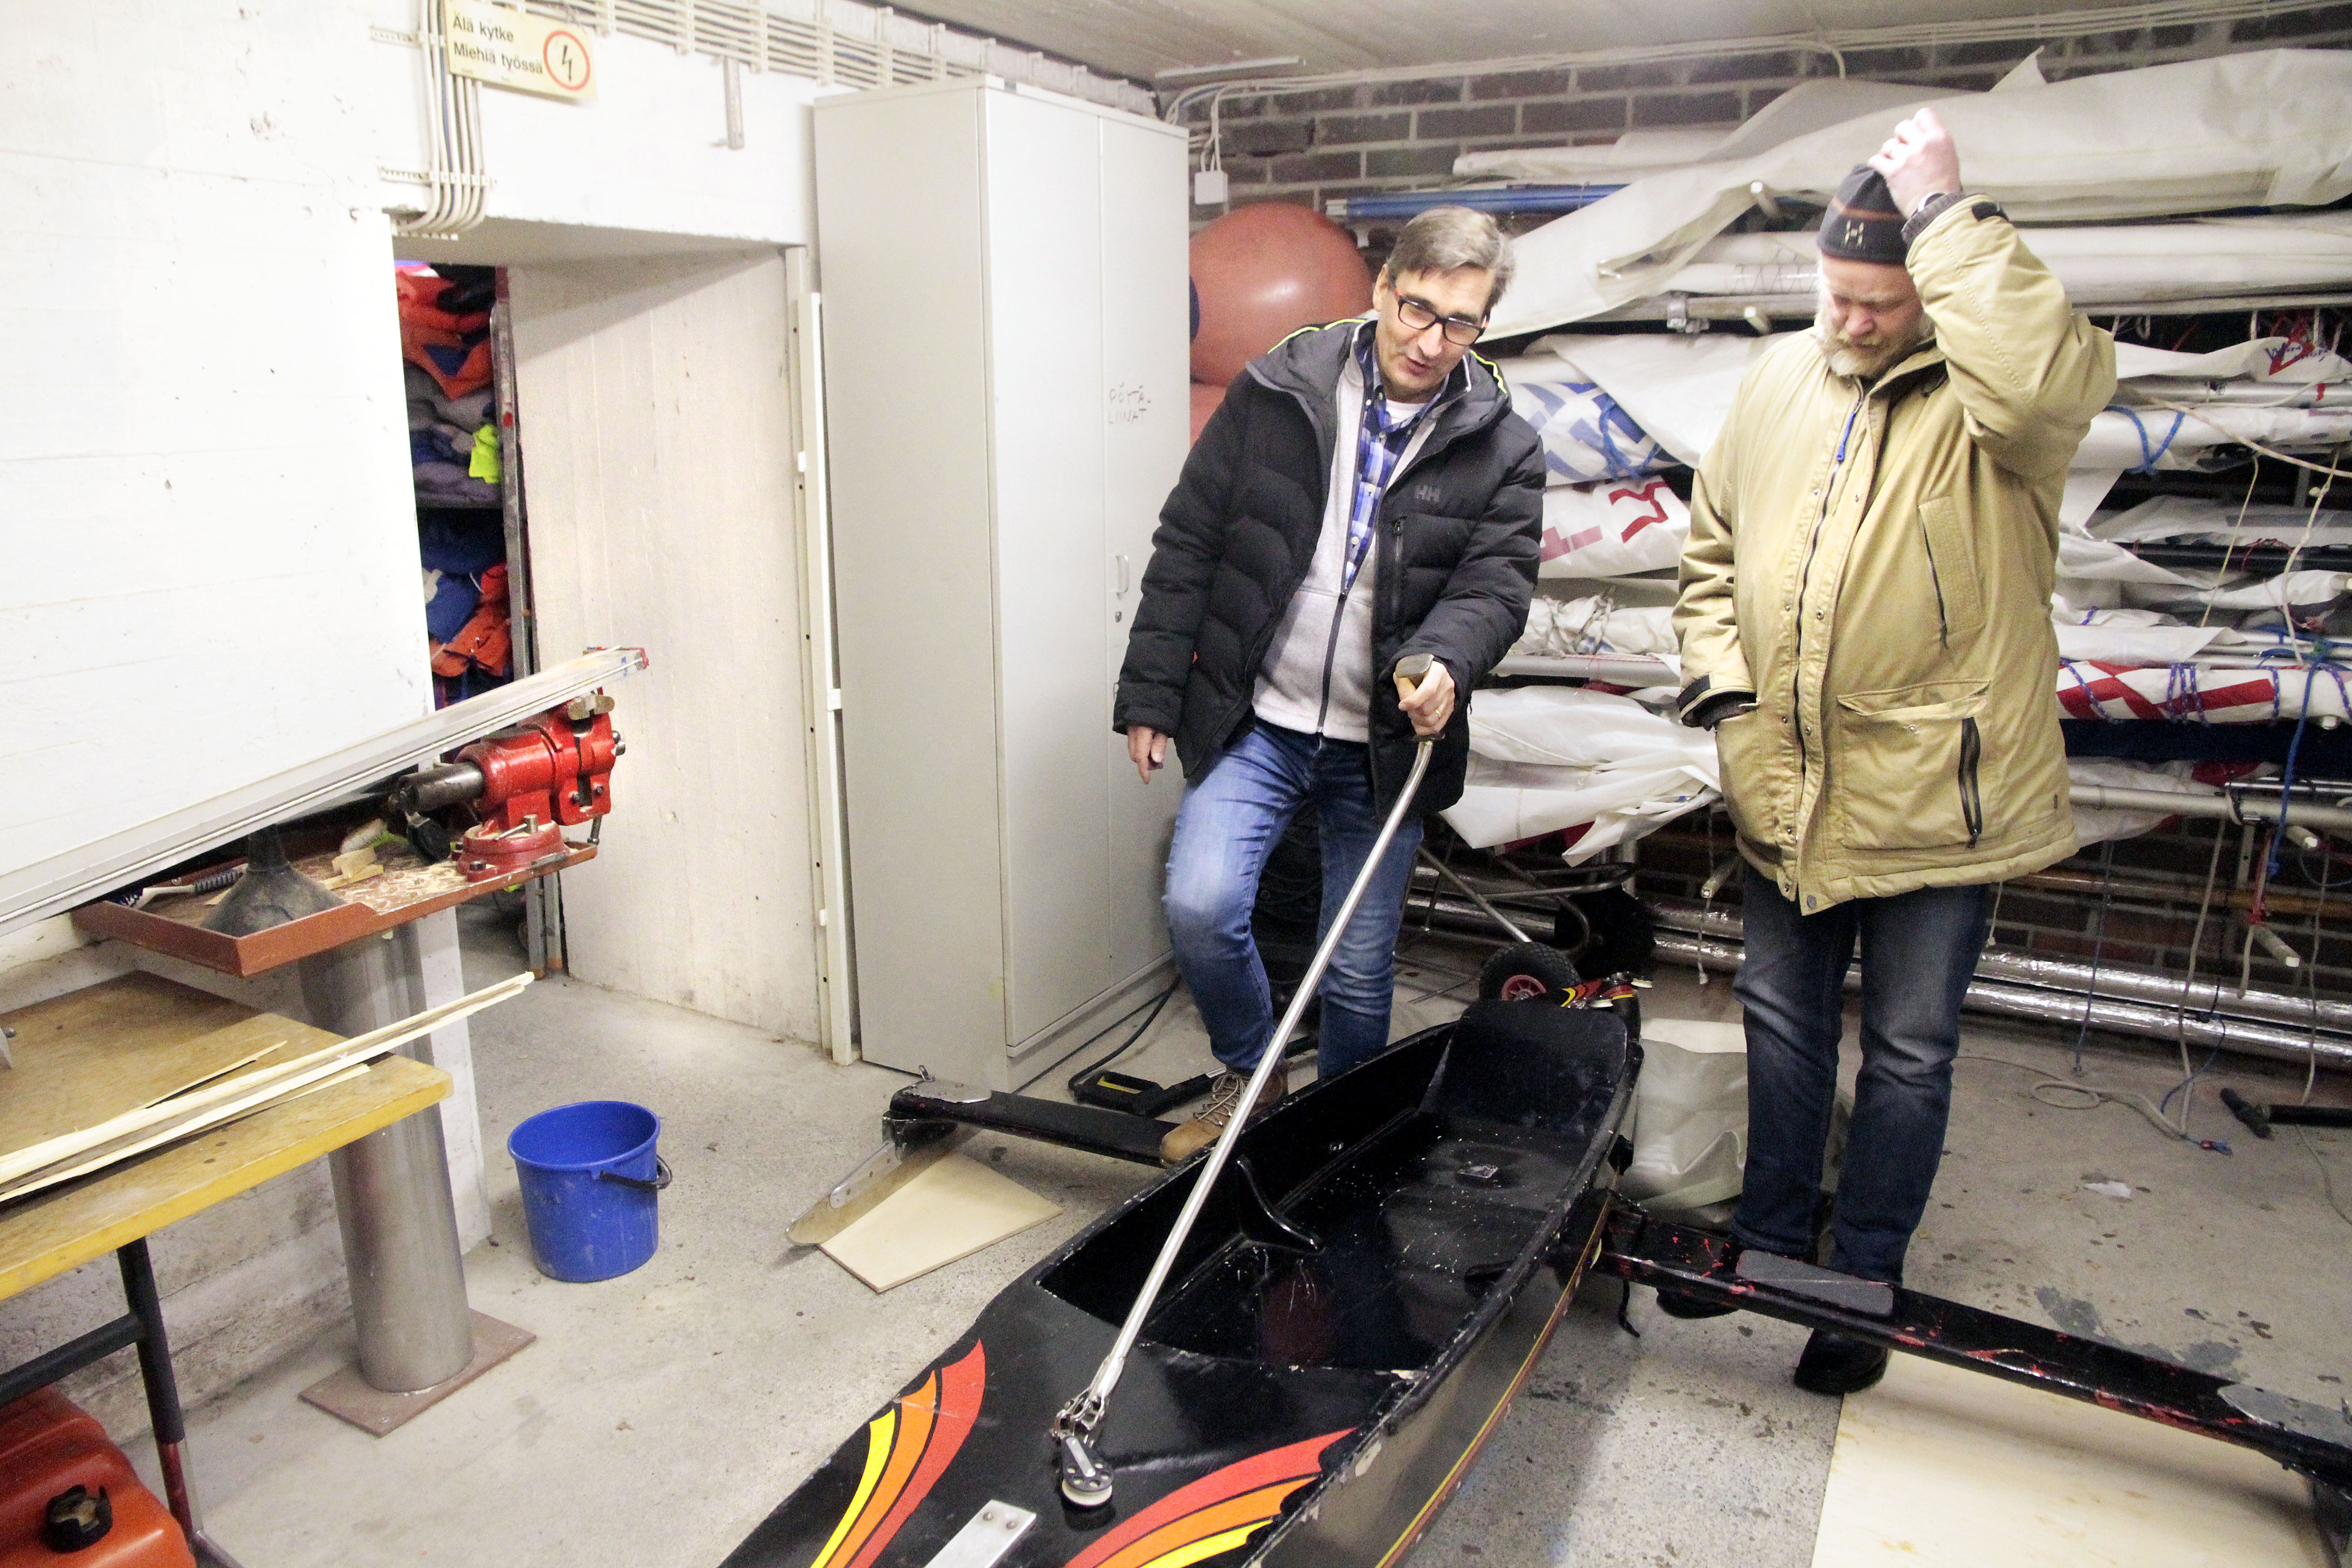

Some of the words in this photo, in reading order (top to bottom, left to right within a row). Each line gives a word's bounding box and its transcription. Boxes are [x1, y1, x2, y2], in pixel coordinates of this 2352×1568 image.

[453, 12, 473, 33] Älä
[480, 21, 514, 43] kytke
[454, 40, 496, 64] Miehiä
[501, 53, 543, 74] työssä
